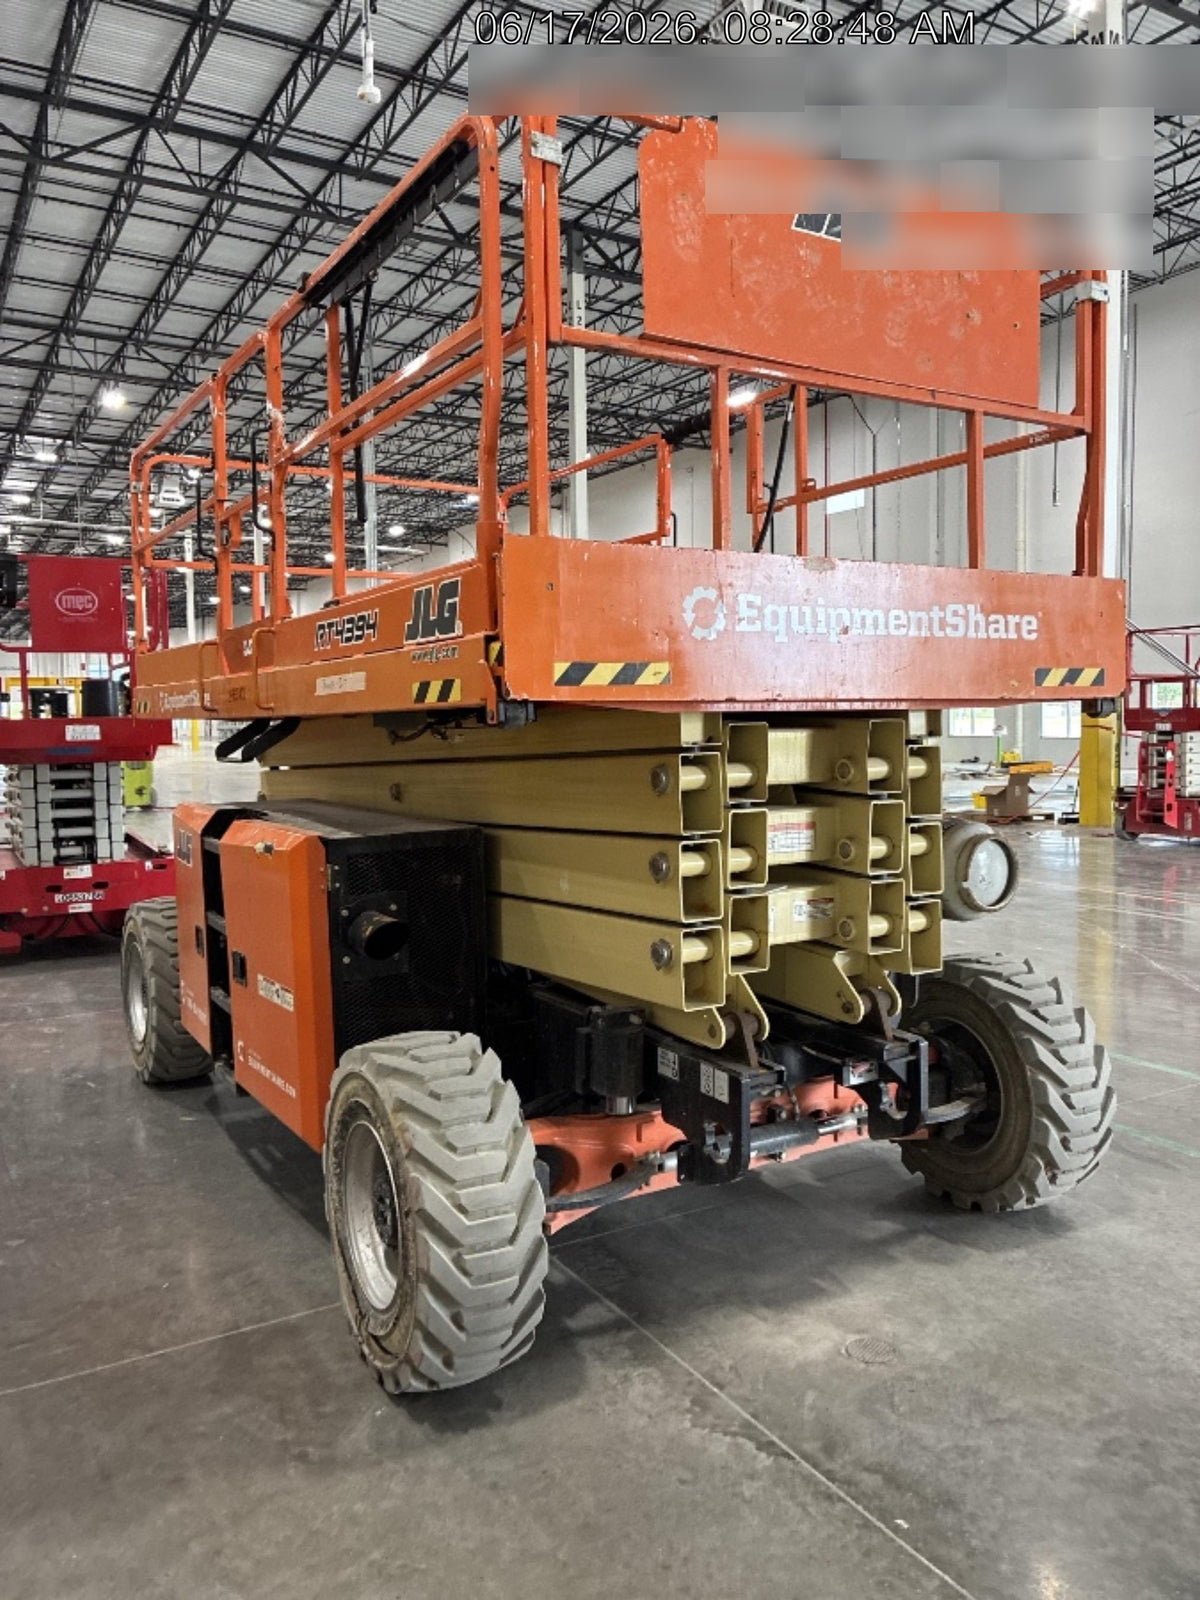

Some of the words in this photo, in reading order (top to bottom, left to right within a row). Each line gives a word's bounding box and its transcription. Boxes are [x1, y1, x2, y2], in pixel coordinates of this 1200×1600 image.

[314, 607, 379, 651] RT4394
[403, 575, 462, 644] JLG
[735, 592, 1039, 643] EquipmentShare
